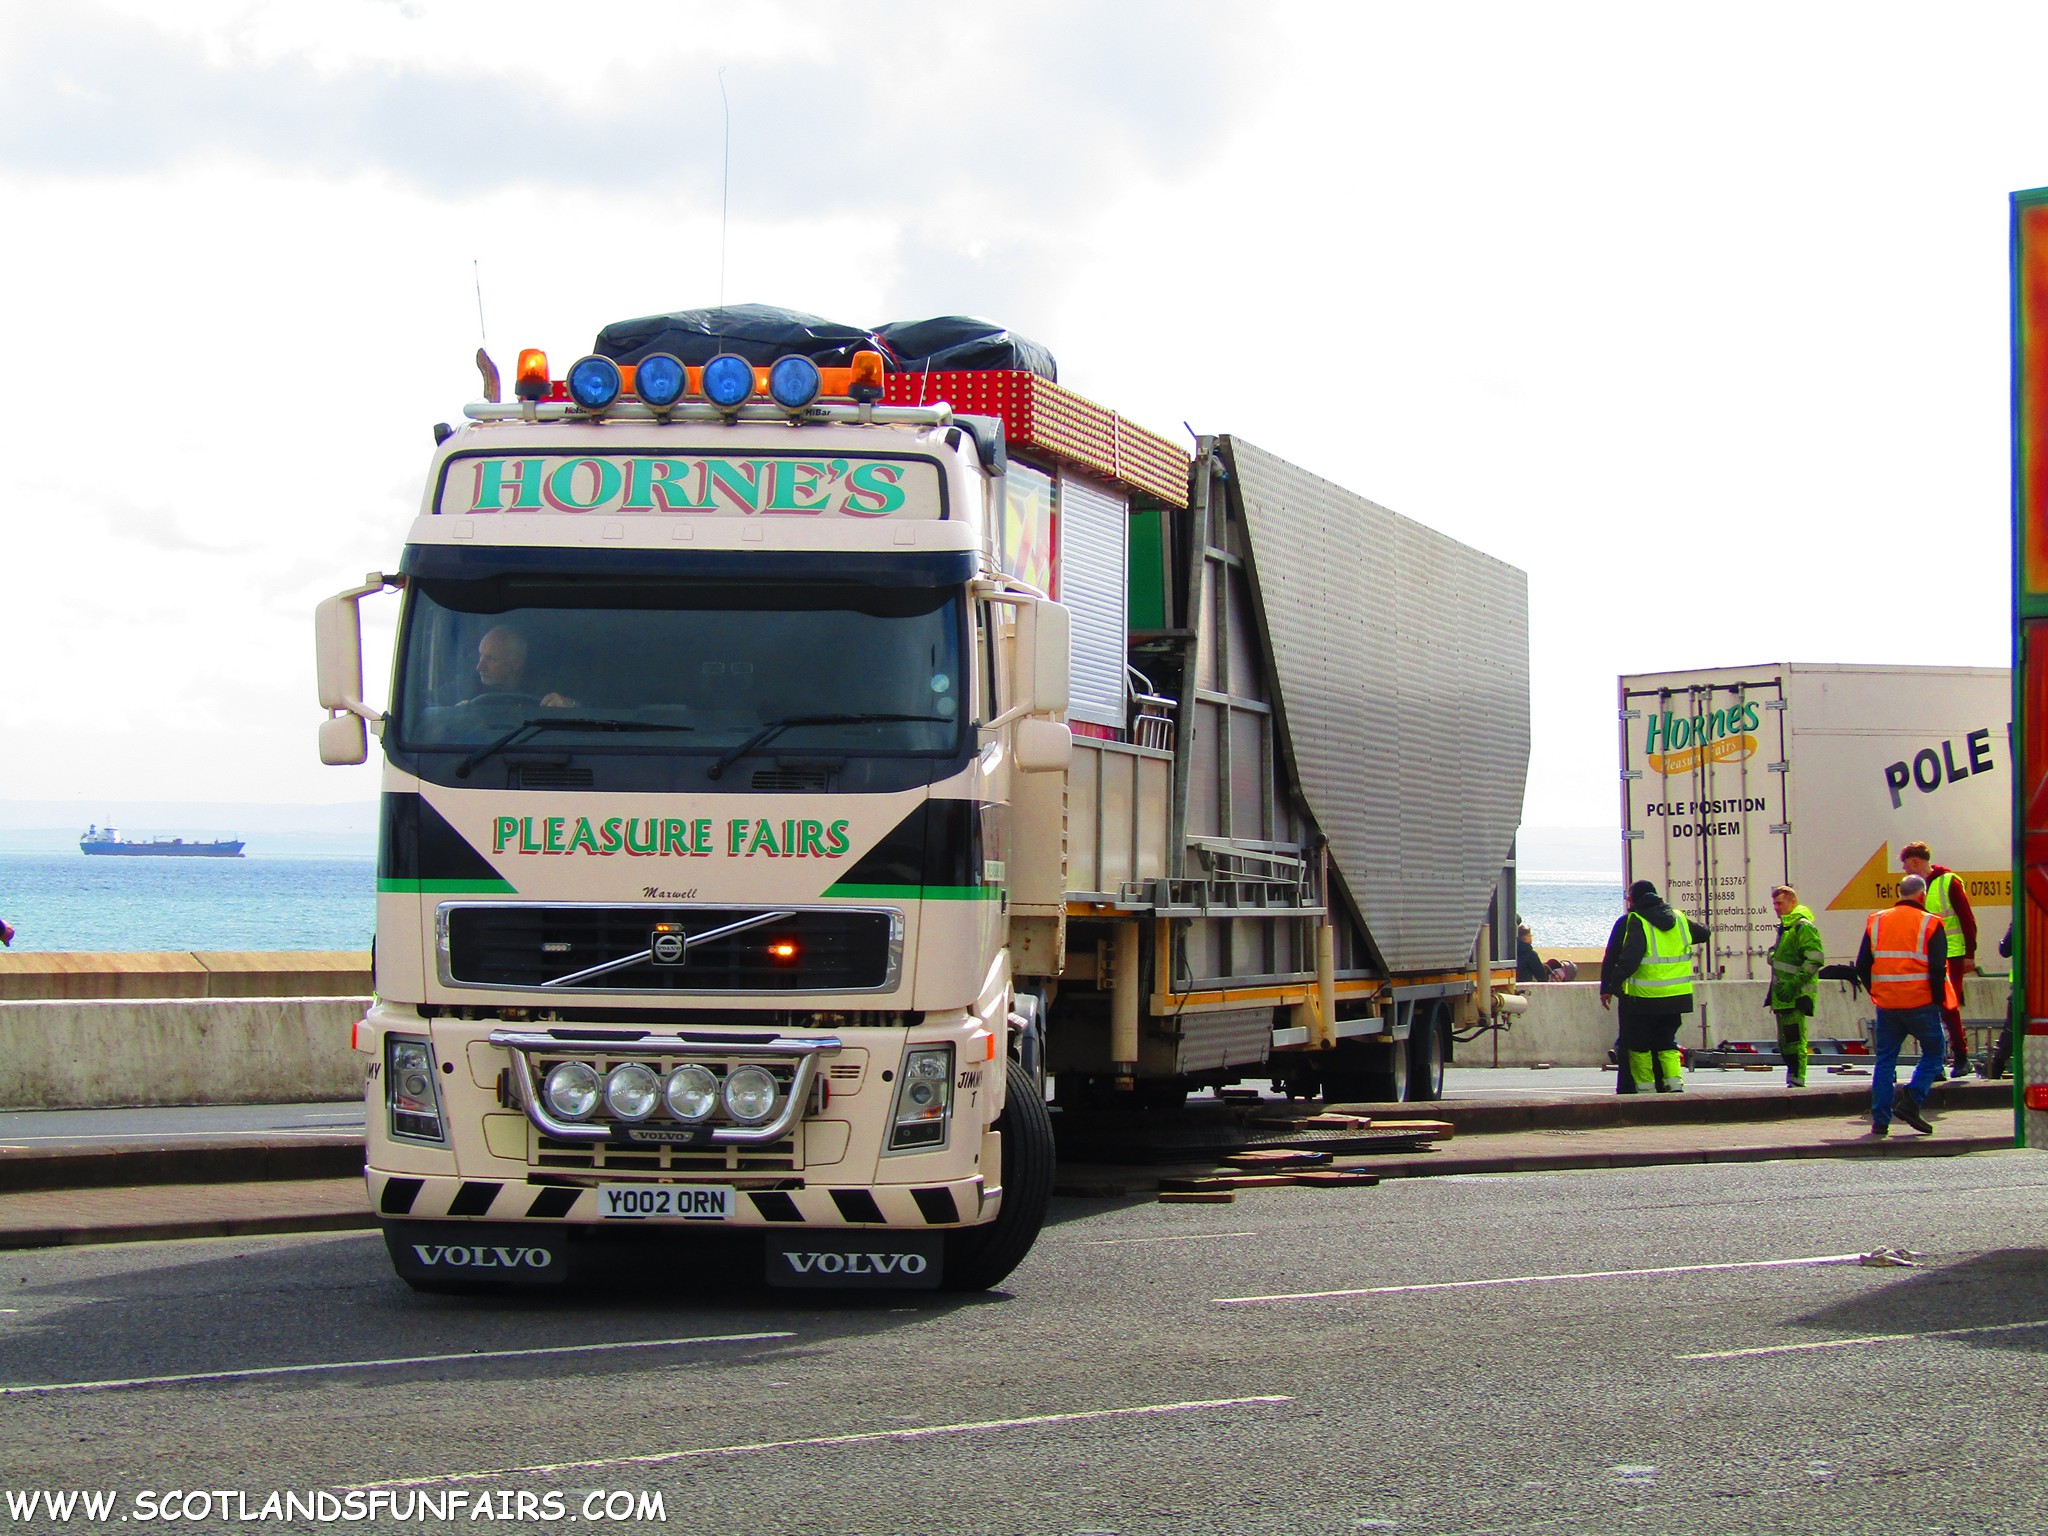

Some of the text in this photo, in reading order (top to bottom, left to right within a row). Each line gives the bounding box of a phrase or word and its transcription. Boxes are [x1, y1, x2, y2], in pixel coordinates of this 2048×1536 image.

[466, 457, 906, 518] HORNE'S
[1884, 727, 1994, 810] POLE
[1646, 797, 1766, 817] POLE POSITION
[493, 816, 850, 859] PLEASURE FAIRS
[1672, 821, 1741, 838] DODGEM
[642, 886, 698, 899] Maxwell
[1668, 878, 1693, 888] Phone:
[1875, 883, 1893, 899] Tel:
[1970, 881, 2001, 896] 07831
[638, 1131, 685, 1141] VOLVO
[411, 1244, 552, 1268] VOLVO
[782, 1251, 928, 1275] VOLVO
